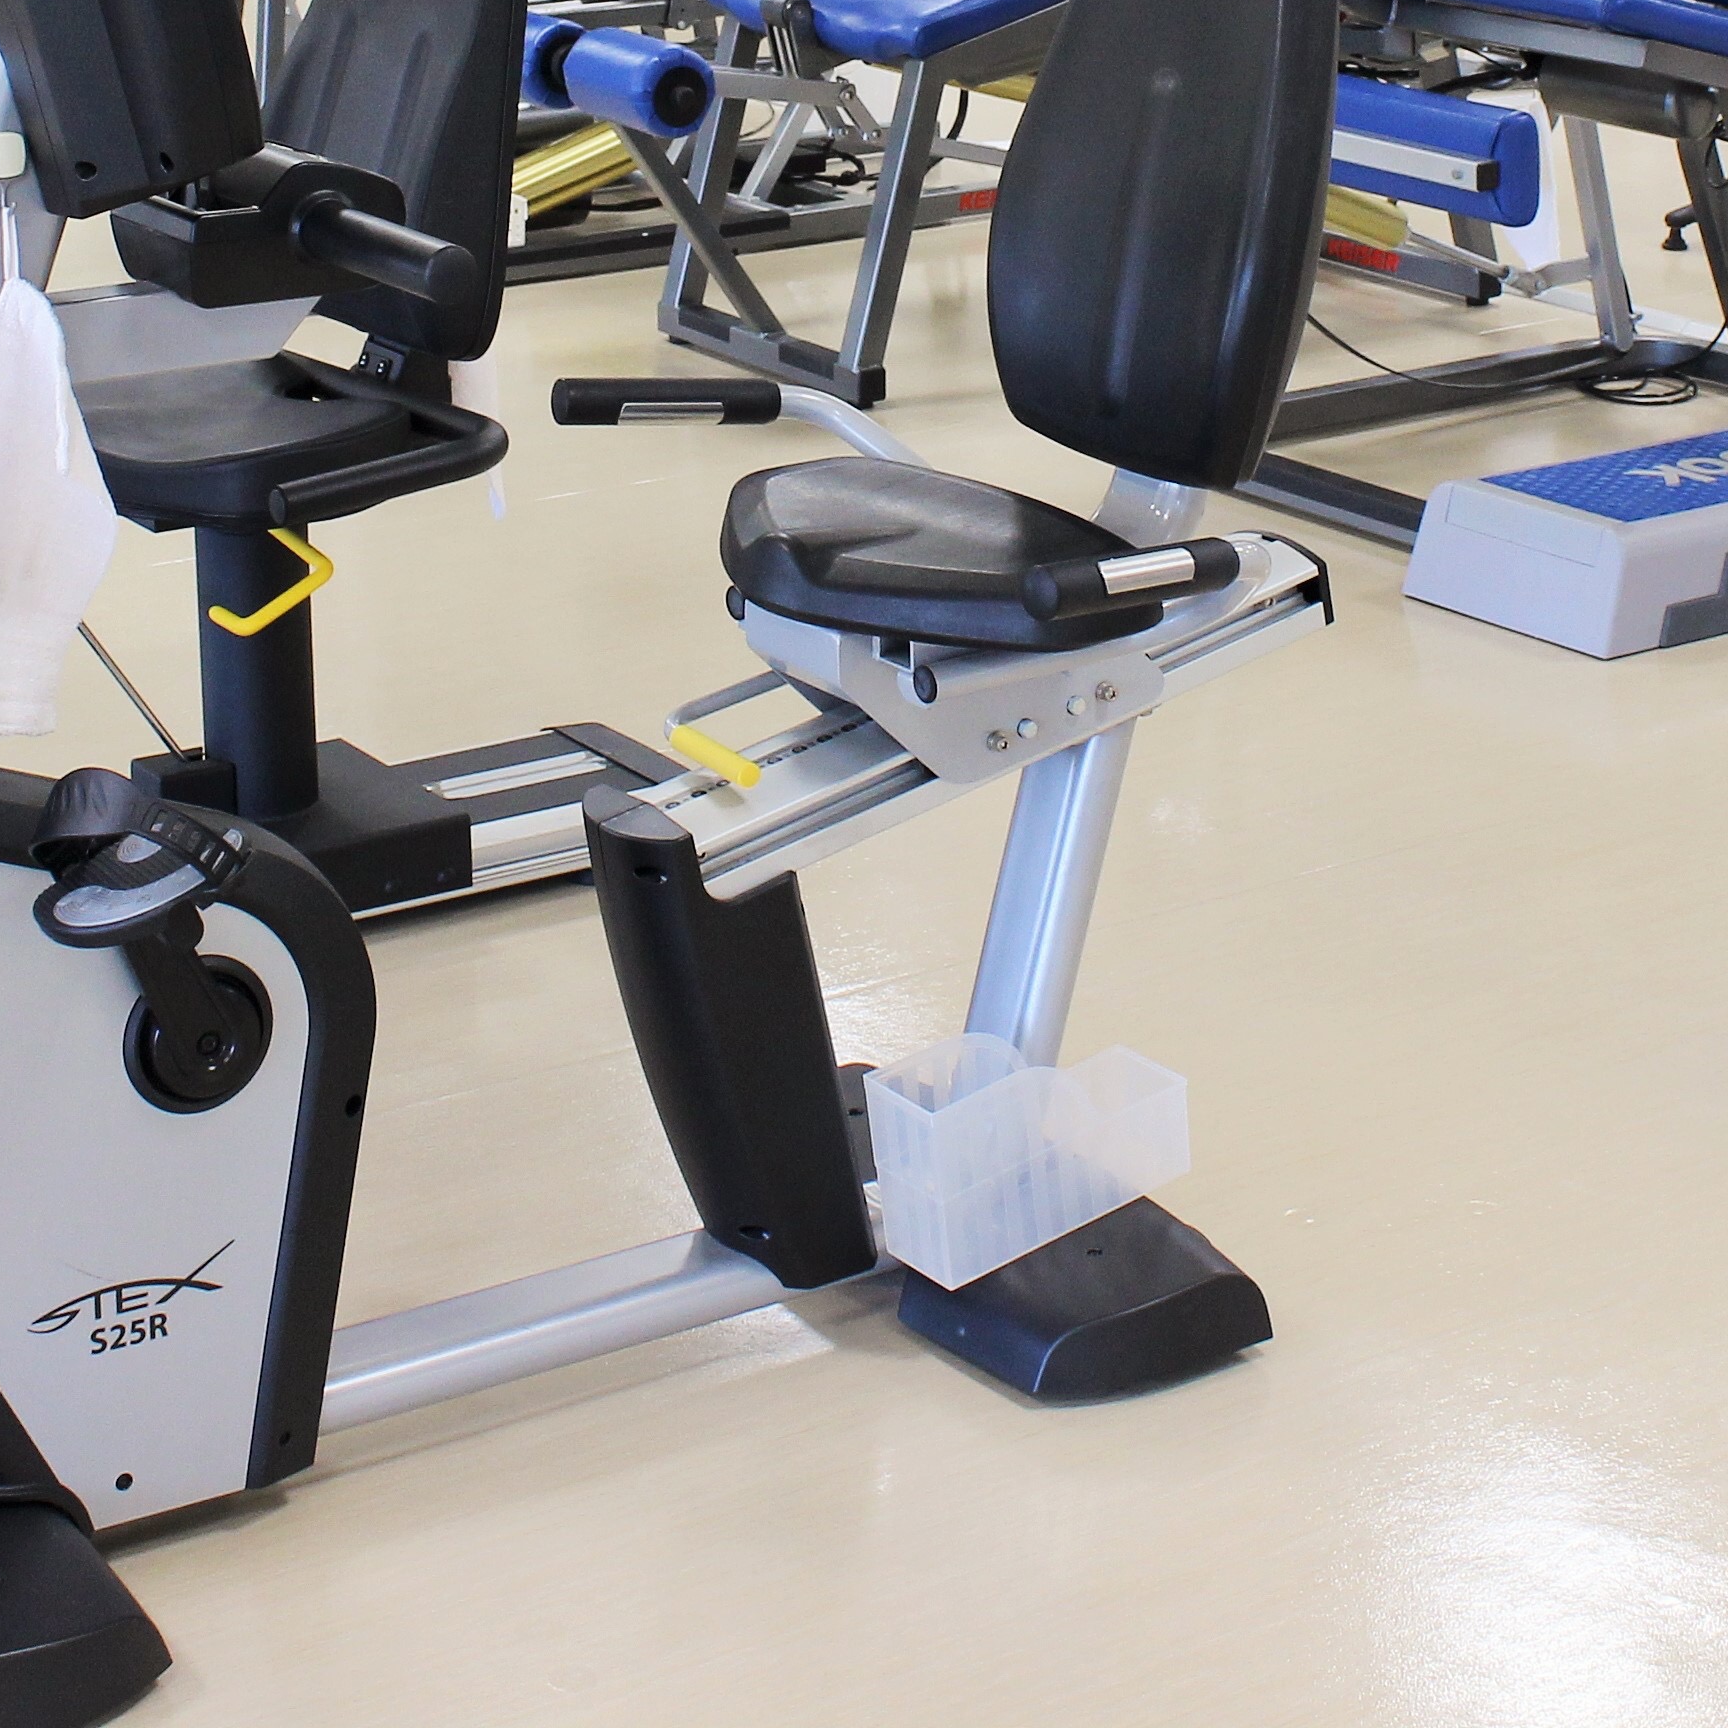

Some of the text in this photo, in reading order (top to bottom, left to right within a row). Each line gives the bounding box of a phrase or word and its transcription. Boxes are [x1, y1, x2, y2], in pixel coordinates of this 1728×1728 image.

[1327, 236, 1400, 273] KEISER
[27, 1238, 236, 1335] STEX
[90, 1312, 169, 1355] S25R
